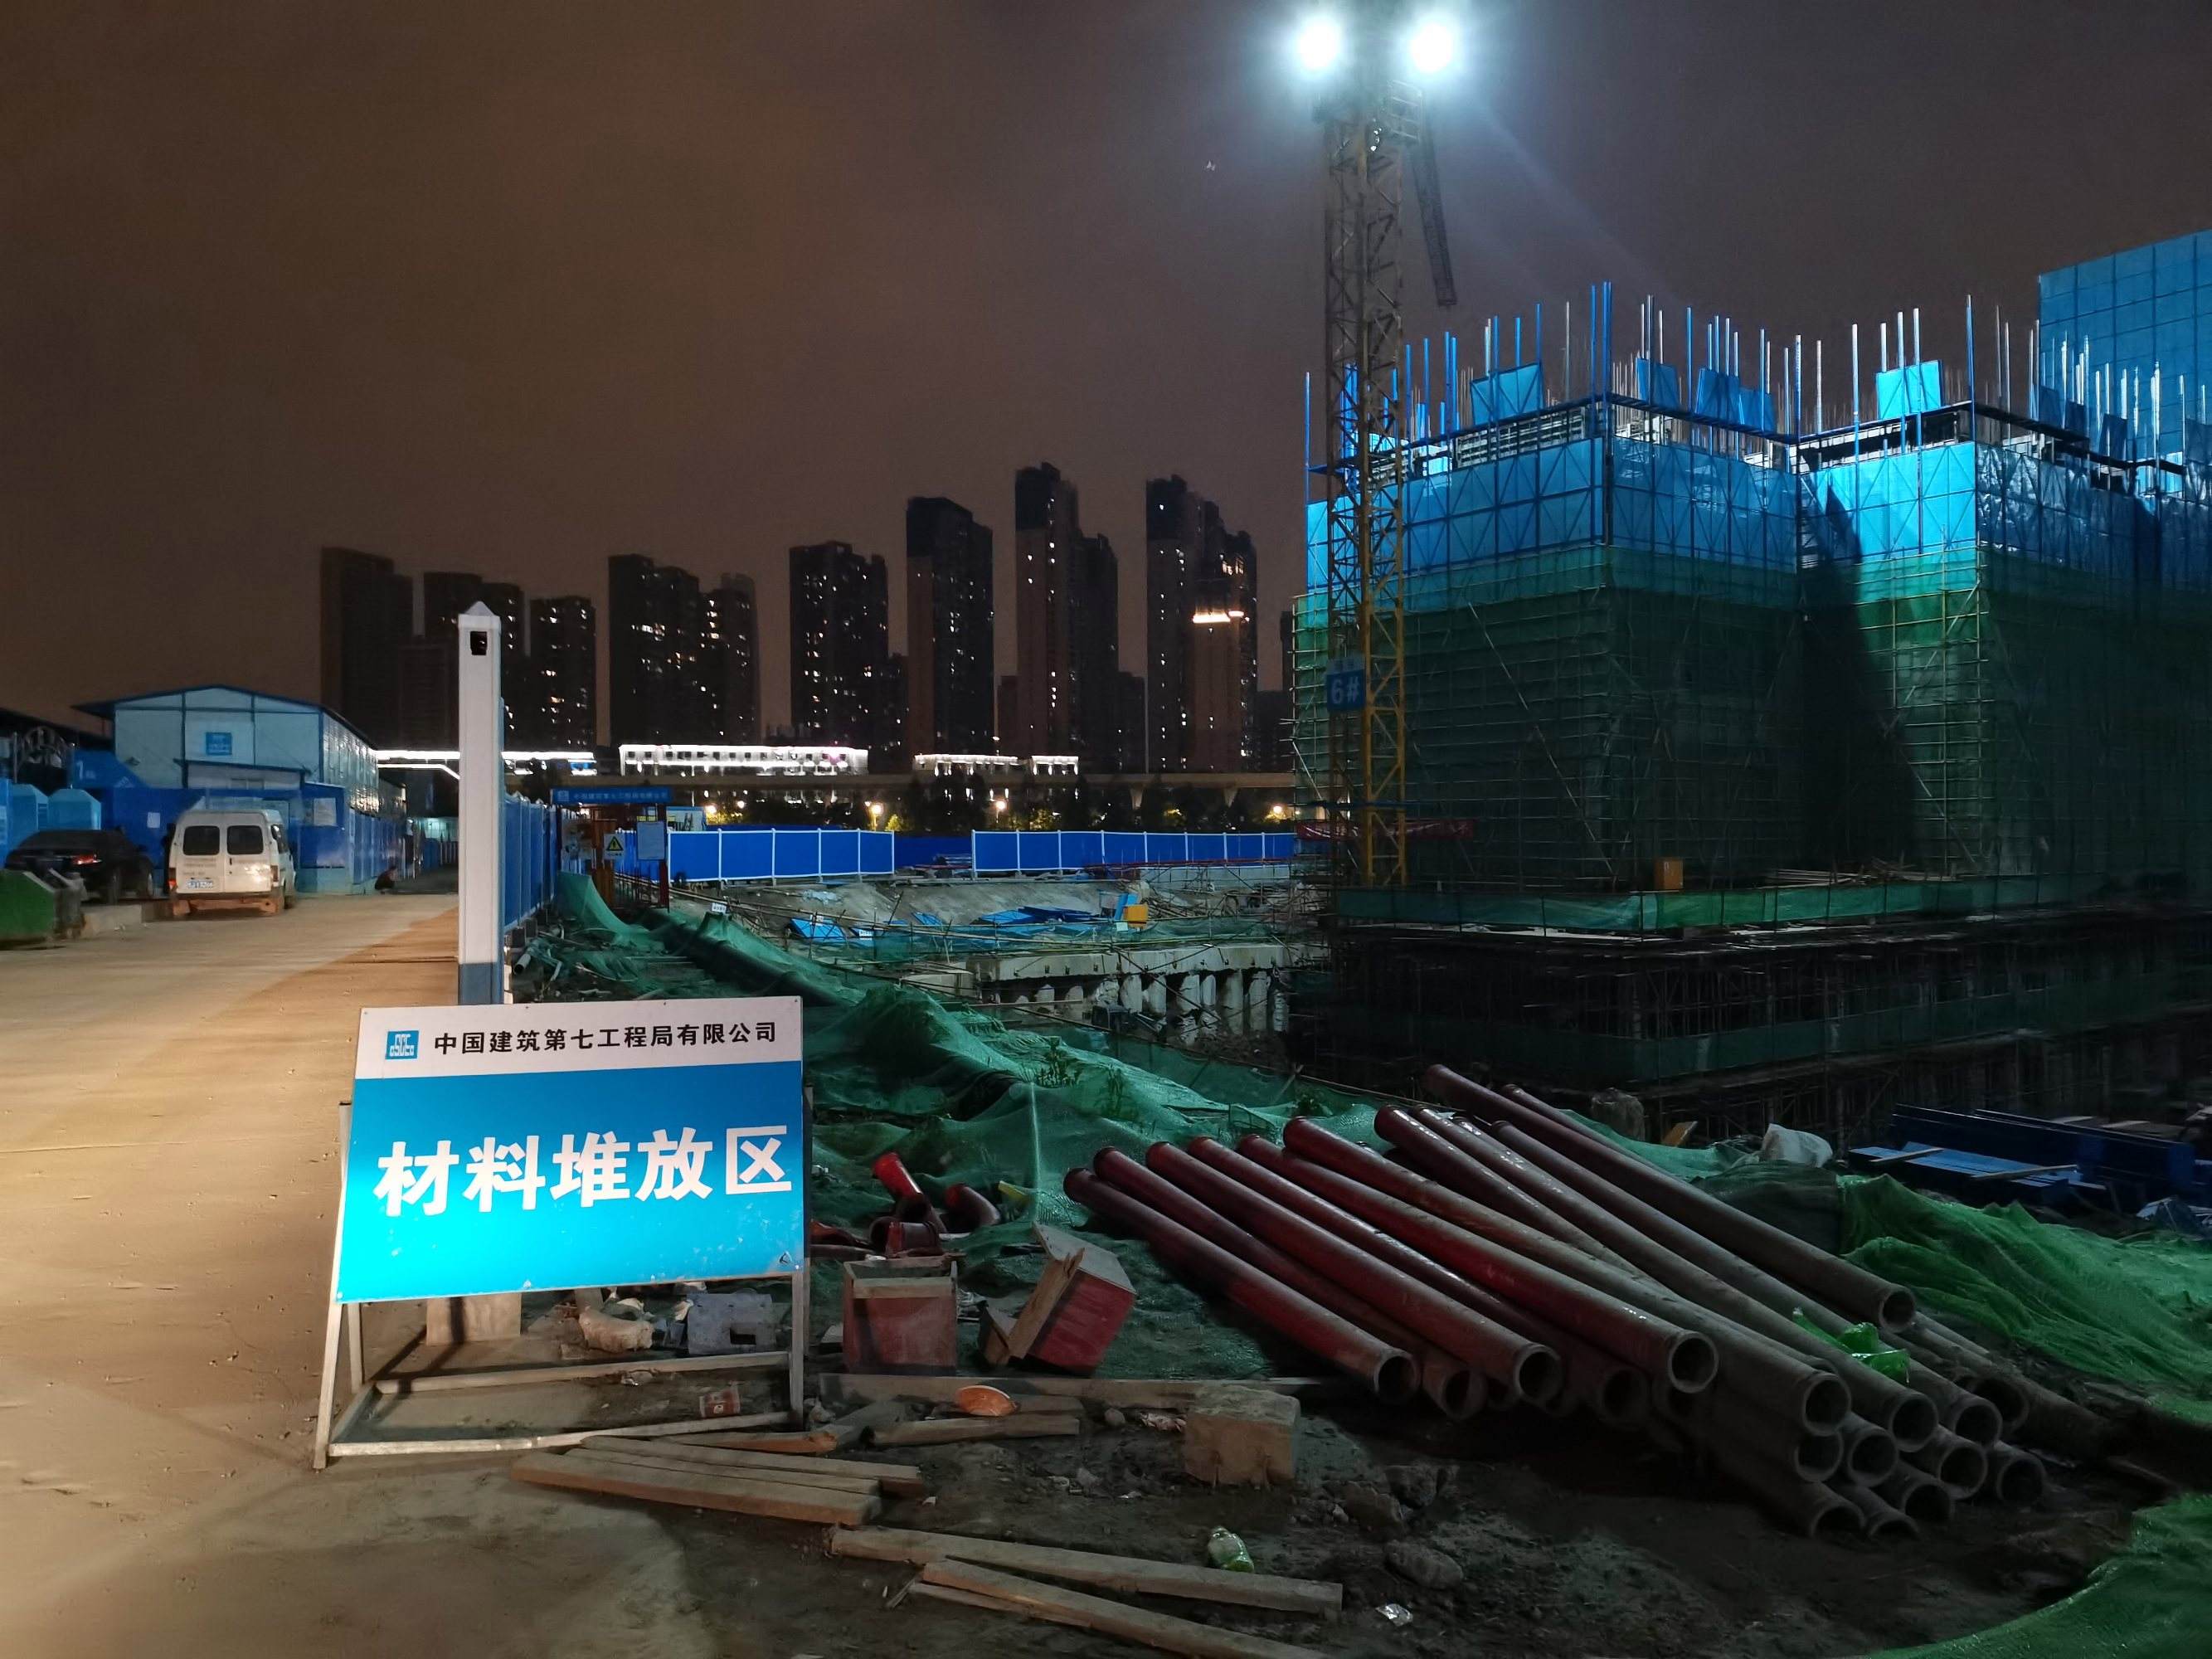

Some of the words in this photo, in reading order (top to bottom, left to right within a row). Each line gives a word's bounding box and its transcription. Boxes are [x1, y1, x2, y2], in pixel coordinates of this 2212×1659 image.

[434, 1021, 777, 1055] 中国建筑第七工程局有限公司
[374, 1126, 791, 1216] 材料堆放区
